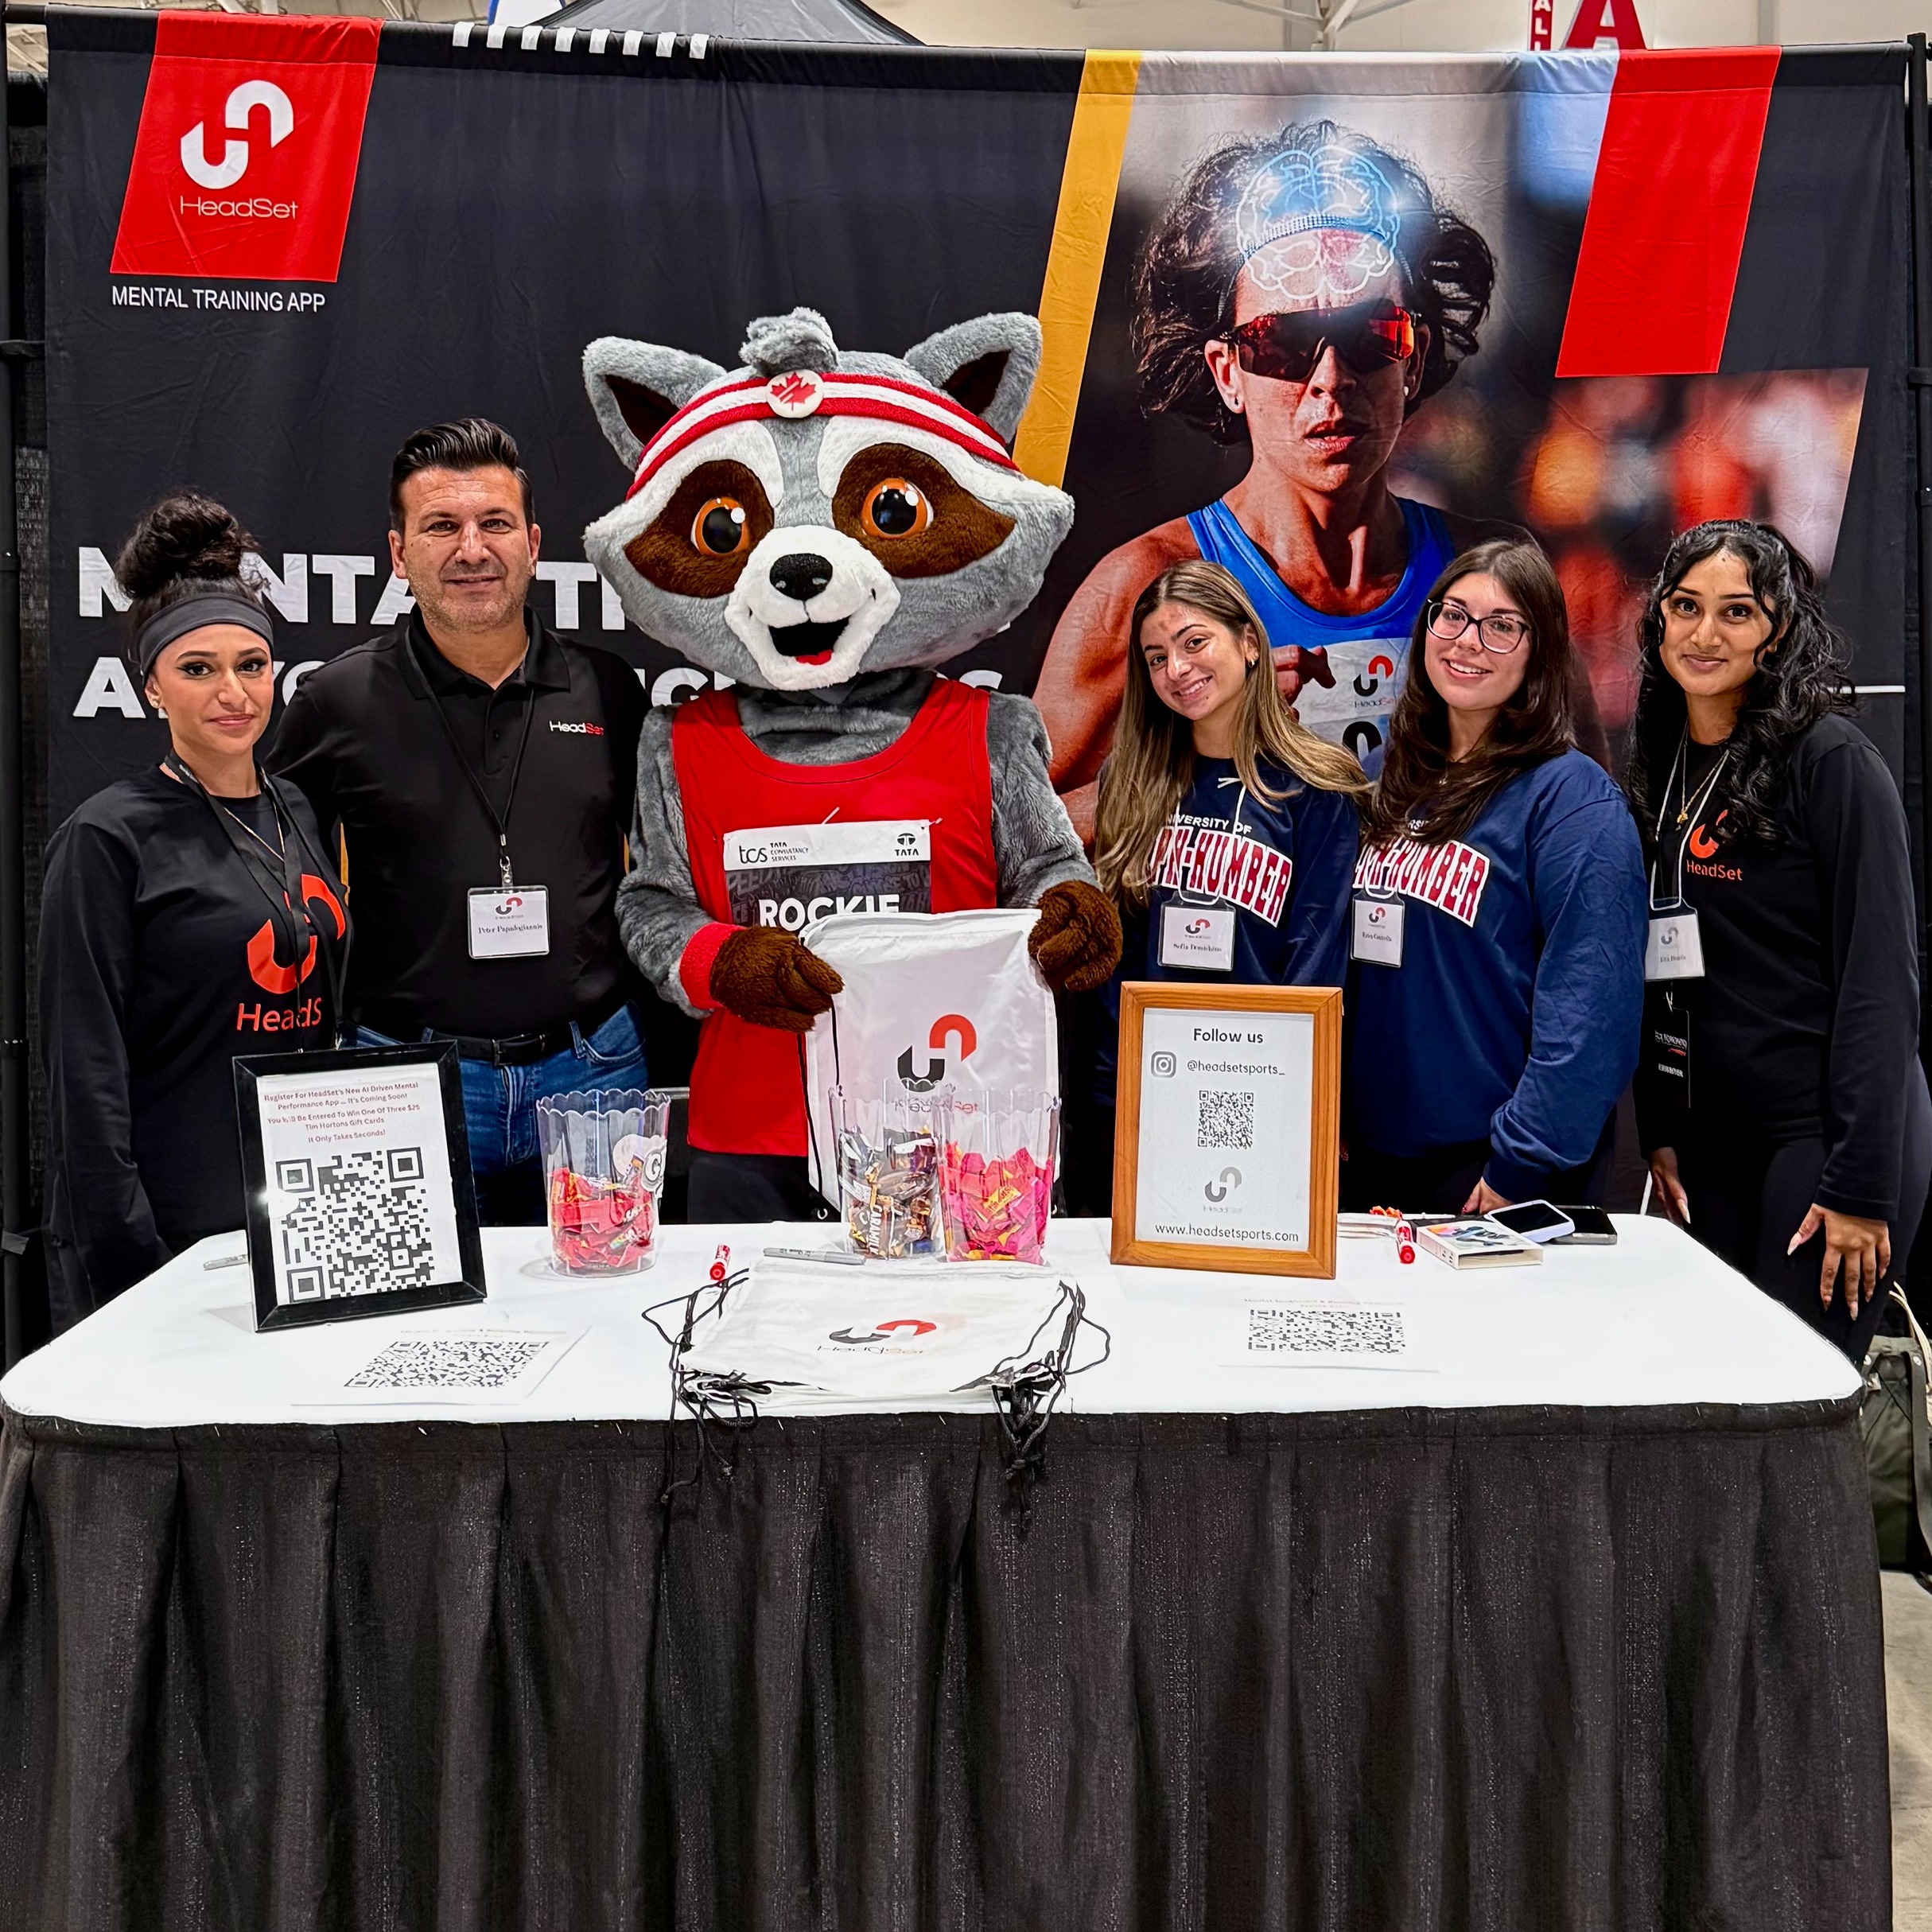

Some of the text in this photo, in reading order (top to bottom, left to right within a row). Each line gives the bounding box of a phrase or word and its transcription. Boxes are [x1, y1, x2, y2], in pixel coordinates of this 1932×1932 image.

[180, 195, 298, 220] HeadSet
[111, 286, 325, 313] MENTAL TRAINING APP
[1234, 821, 1253, 835] OF
[738, 845, 768, 865] tcs
[770, 847, 809, 856] CONSULTANCY
[894, 848, 919, 857] TATA
[1686, 859, 1743, 881] HeadSet
[1193, 1028, 1264, 1044] Follow us
[1187, 1059, 1285, 1076] @headsetsports_
[264, 1094, 293, 1103] Register
[308, 1088, 344, 1098] HeadSet's
[371, 1084, 394, 1093] Driven
[395, 1082, 419, 1090] Mental
[278, 1100, 324, 1110] Performance
[308, 1112, 336, 1121] Entered
[320, 1121, 348, 1129] Hortons
[315, 1134, 332, 1143] Only
[353, 1129, 386, 1139] Seconds!
[1155, 1223, 1299, 1242] www.headsetsports.com
